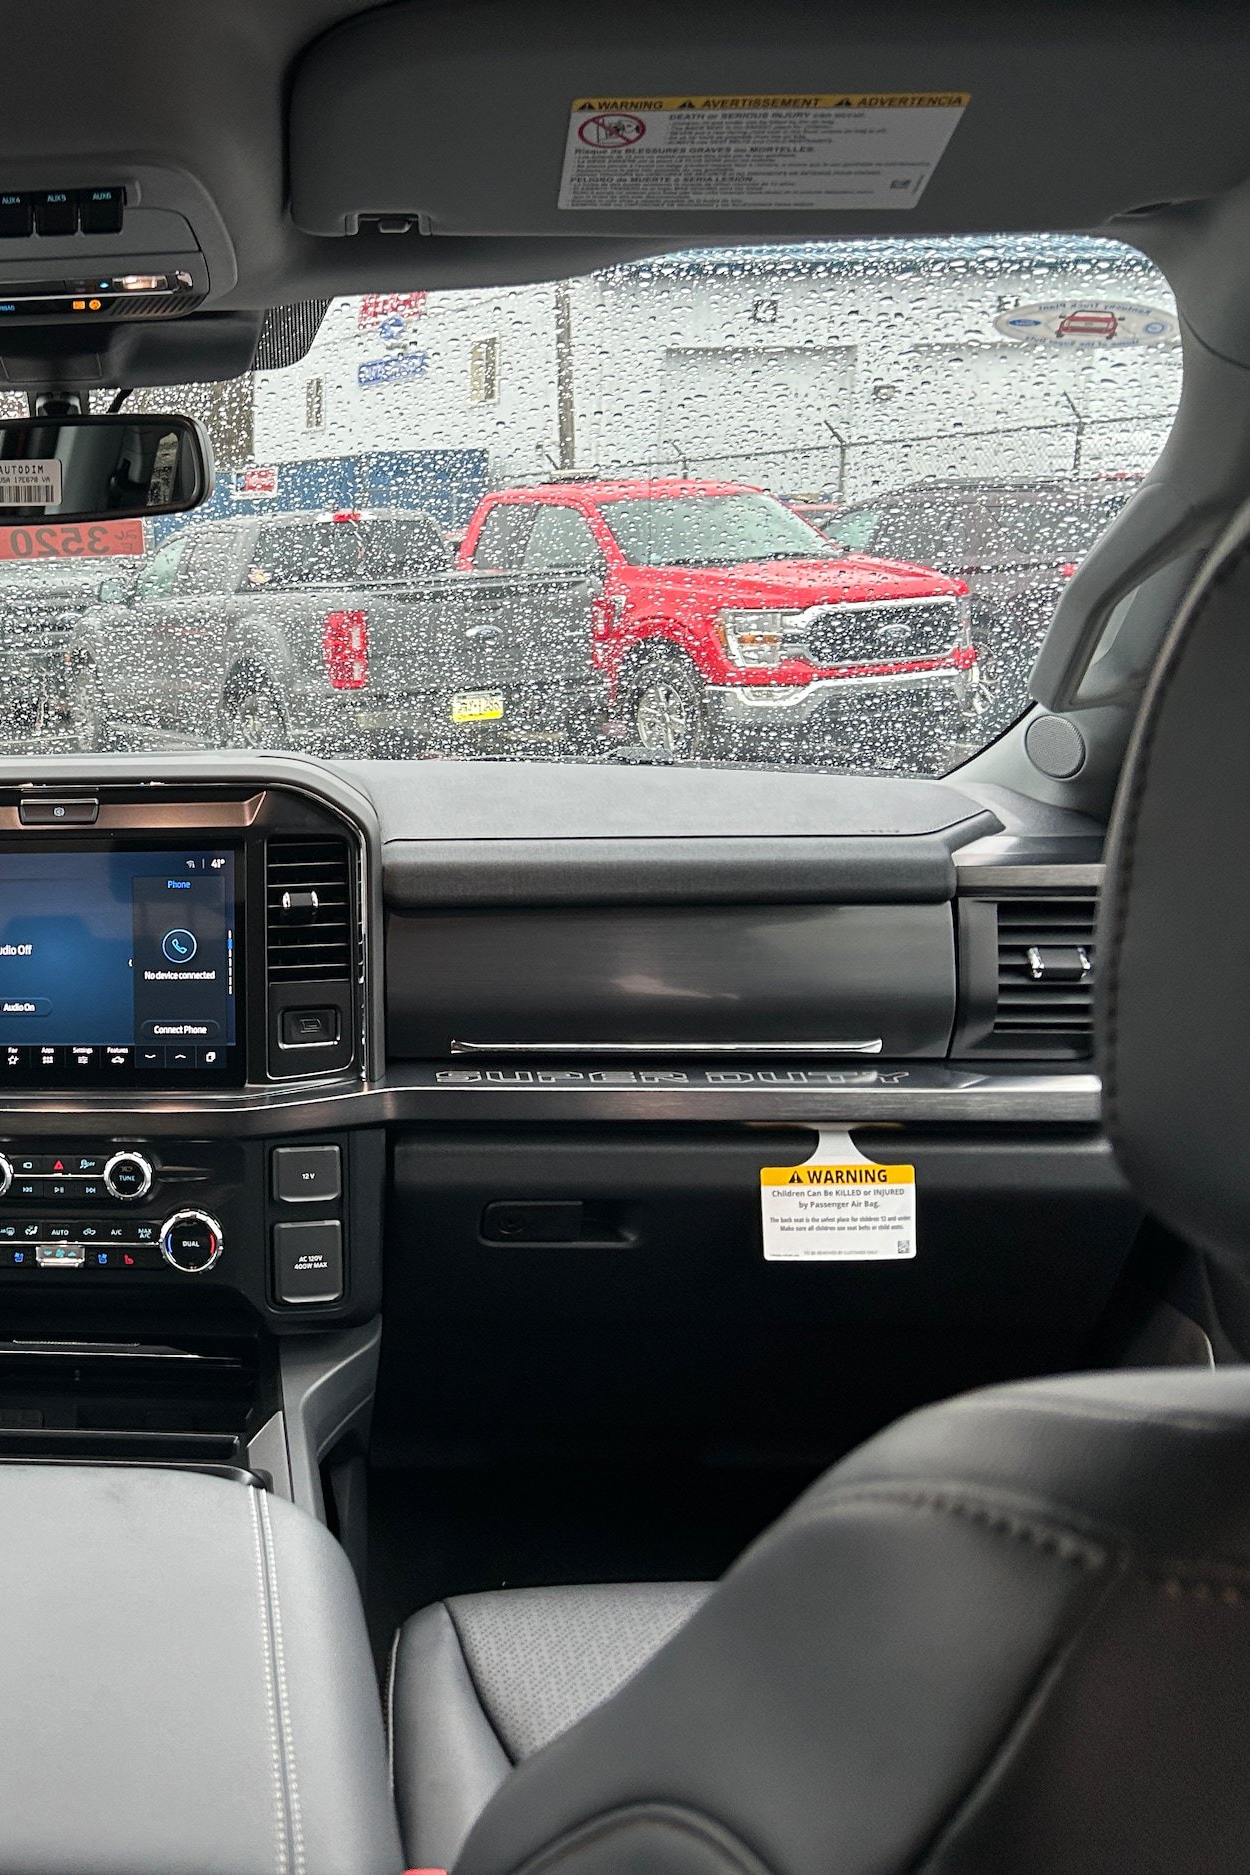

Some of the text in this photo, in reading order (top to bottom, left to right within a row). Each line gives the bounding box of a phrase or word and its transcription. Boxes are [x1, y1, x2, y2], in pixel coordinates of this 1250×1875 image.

[597, 101, 663, 110] WARNING
[701, 98, 819, 109] AVERTISSEMENT
[856, 96, 962, 107] ADVERTENCIA
[167, 880, 191, 889] Phone
[17, 944, 33, 955] Off
[144, 971, 216, 980] No device connected
[3, 1002, 36, 1012] Audio On
[154, 1025, 207, 1035] Connect Phone
[41, 1047, 54, 1055] Apps
[72, 1047, 93, 1055] Settings
[107, 1047, 129, 1055] Features
[435, 1069, 911, 1085] SUPER DUTY
[807, 1169, 888, 1184] WARNING
[772, 1190, 805, 1198] Children
[835, 1189, 862, 1197] KILLED
[873, 1188, 905, 1197] INJURED
[798, 1200, 880, 1210] by Passenger Air Bag.
[837, 1216, 849, 1224] place
[182, 1240, 200, 1248] DUAL
[294, 1261, 328, 1271] 400W MAX
